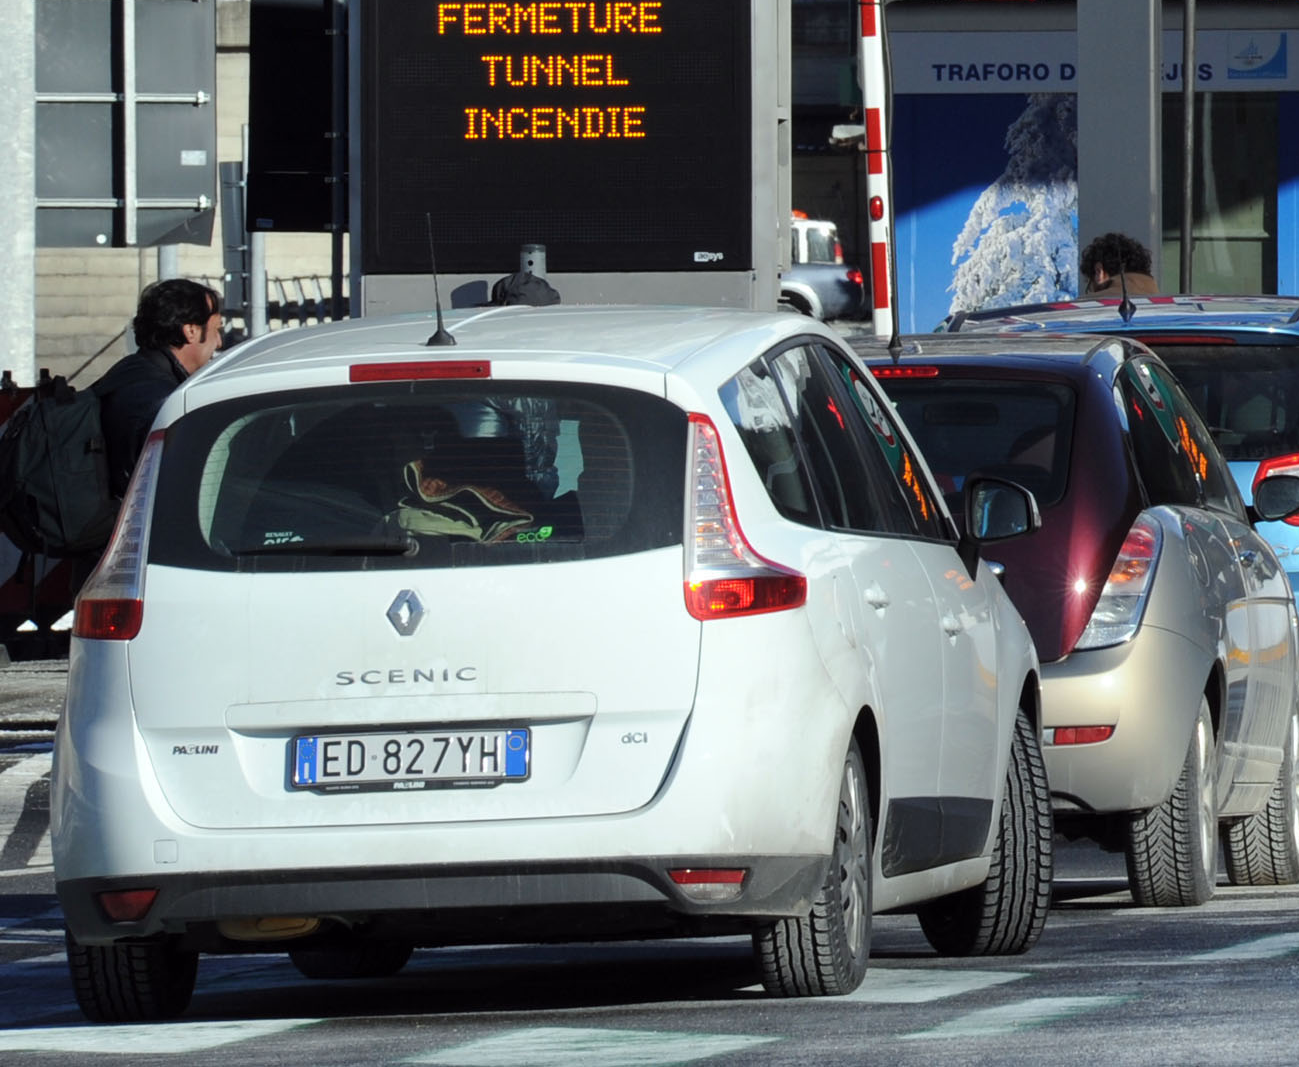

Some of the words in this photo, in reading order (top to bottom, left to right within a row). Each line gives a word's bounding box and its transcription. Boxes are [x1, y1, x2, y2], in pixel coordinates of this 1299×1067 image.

[437, 1, 663, 35] FERMETURE
[481, 54, 629, 88] TUNNEL
[932, 63, 1050, 82] TRAFORO
[464, 106, 646, 140] INCENDIE
[335, 667, 477, 687] SCENIC
